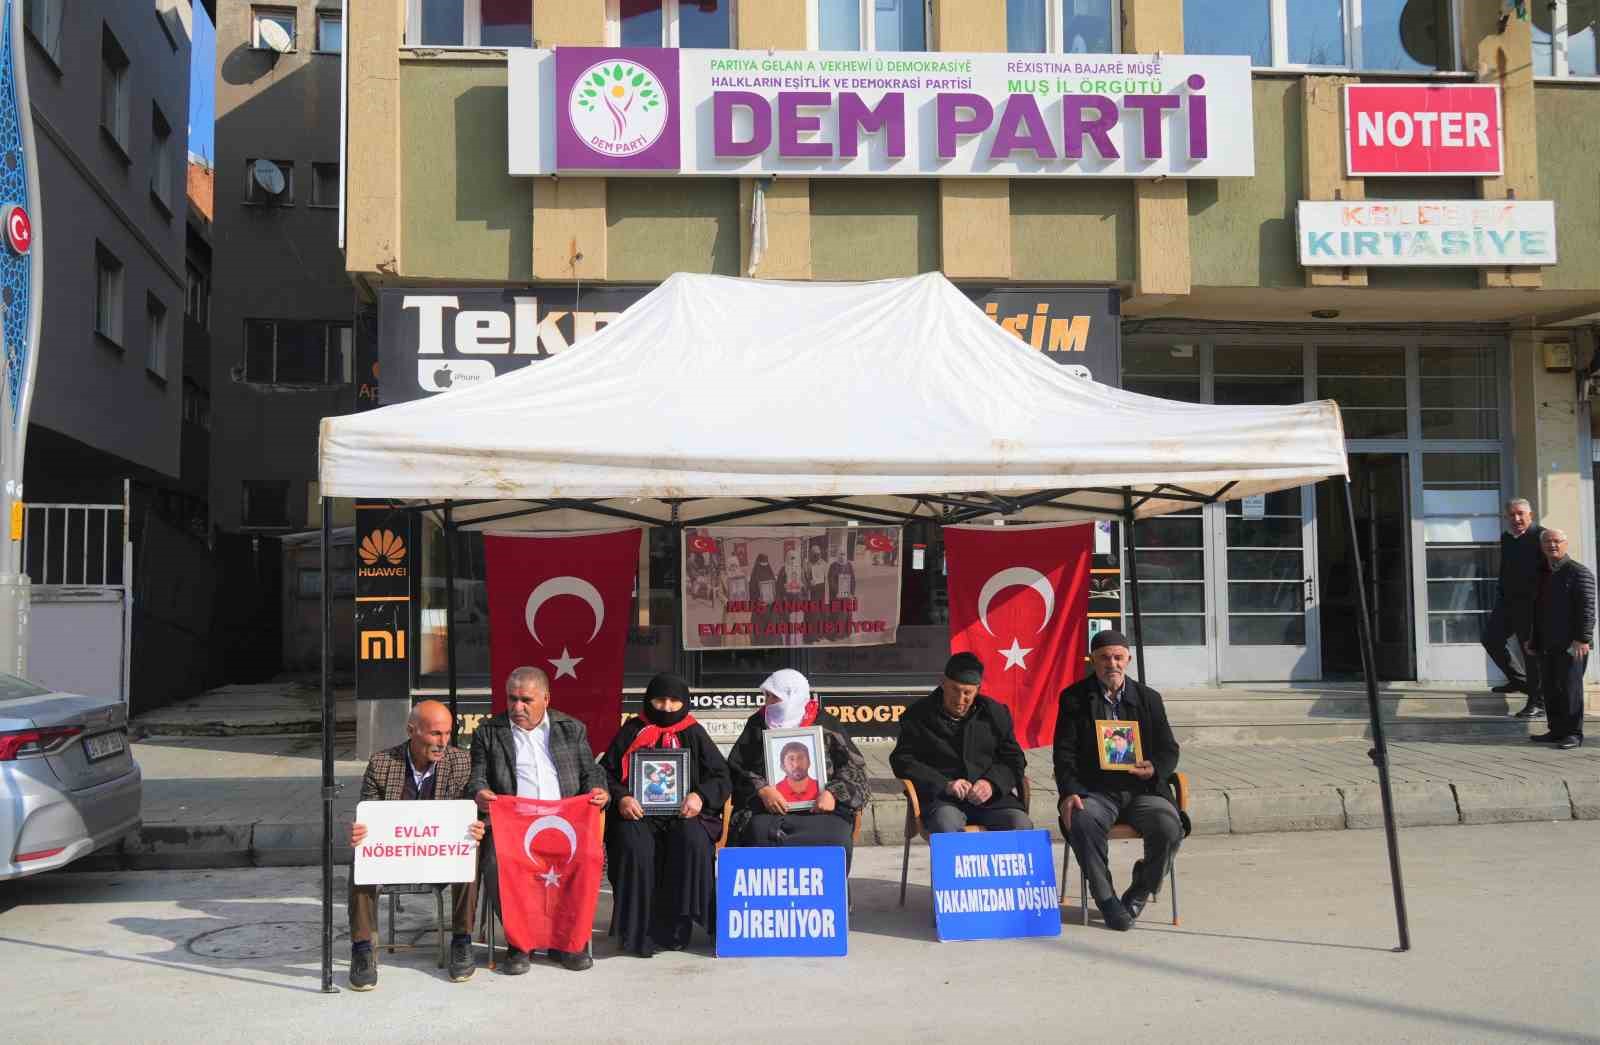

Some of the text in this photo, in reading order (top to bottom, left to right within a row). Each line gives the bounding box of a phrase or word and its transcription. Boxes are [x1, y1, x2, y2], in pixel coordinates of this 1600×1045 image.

[761, 60, 803, 72] GELAN
[807, 61, 816, 72] A
[711, 76, 972, 89] HALKLARIN EŞİTLİK VE DEMOKRASİ PARTİSİ
[1008, 78, 1163, 95] MUŞ İL ÖRGÜTÜ
[713, 74, 1209, 161] DEM PARTİ
[1357, 111, 1491, 148] NOTER
[591, 133, 648, 152] DEM PARTİ
[1307, 226, 1549, 258] KIRTASİYE
[358, 567, 407, 577] HUAWEI
[394, 826, 440, 838] EVLAT
[362, 842, 470, 857] NÖBETİNDEYİZ
[955, 855, 990, 878] ARTIK
[991, 853, 1027, 877] YETER
[733, 868, 824, 896] ANNELER
[936, 887, 1015, 913] YAKAMIZDAN
[728, 901, 836, 938] DİRENİYOR
